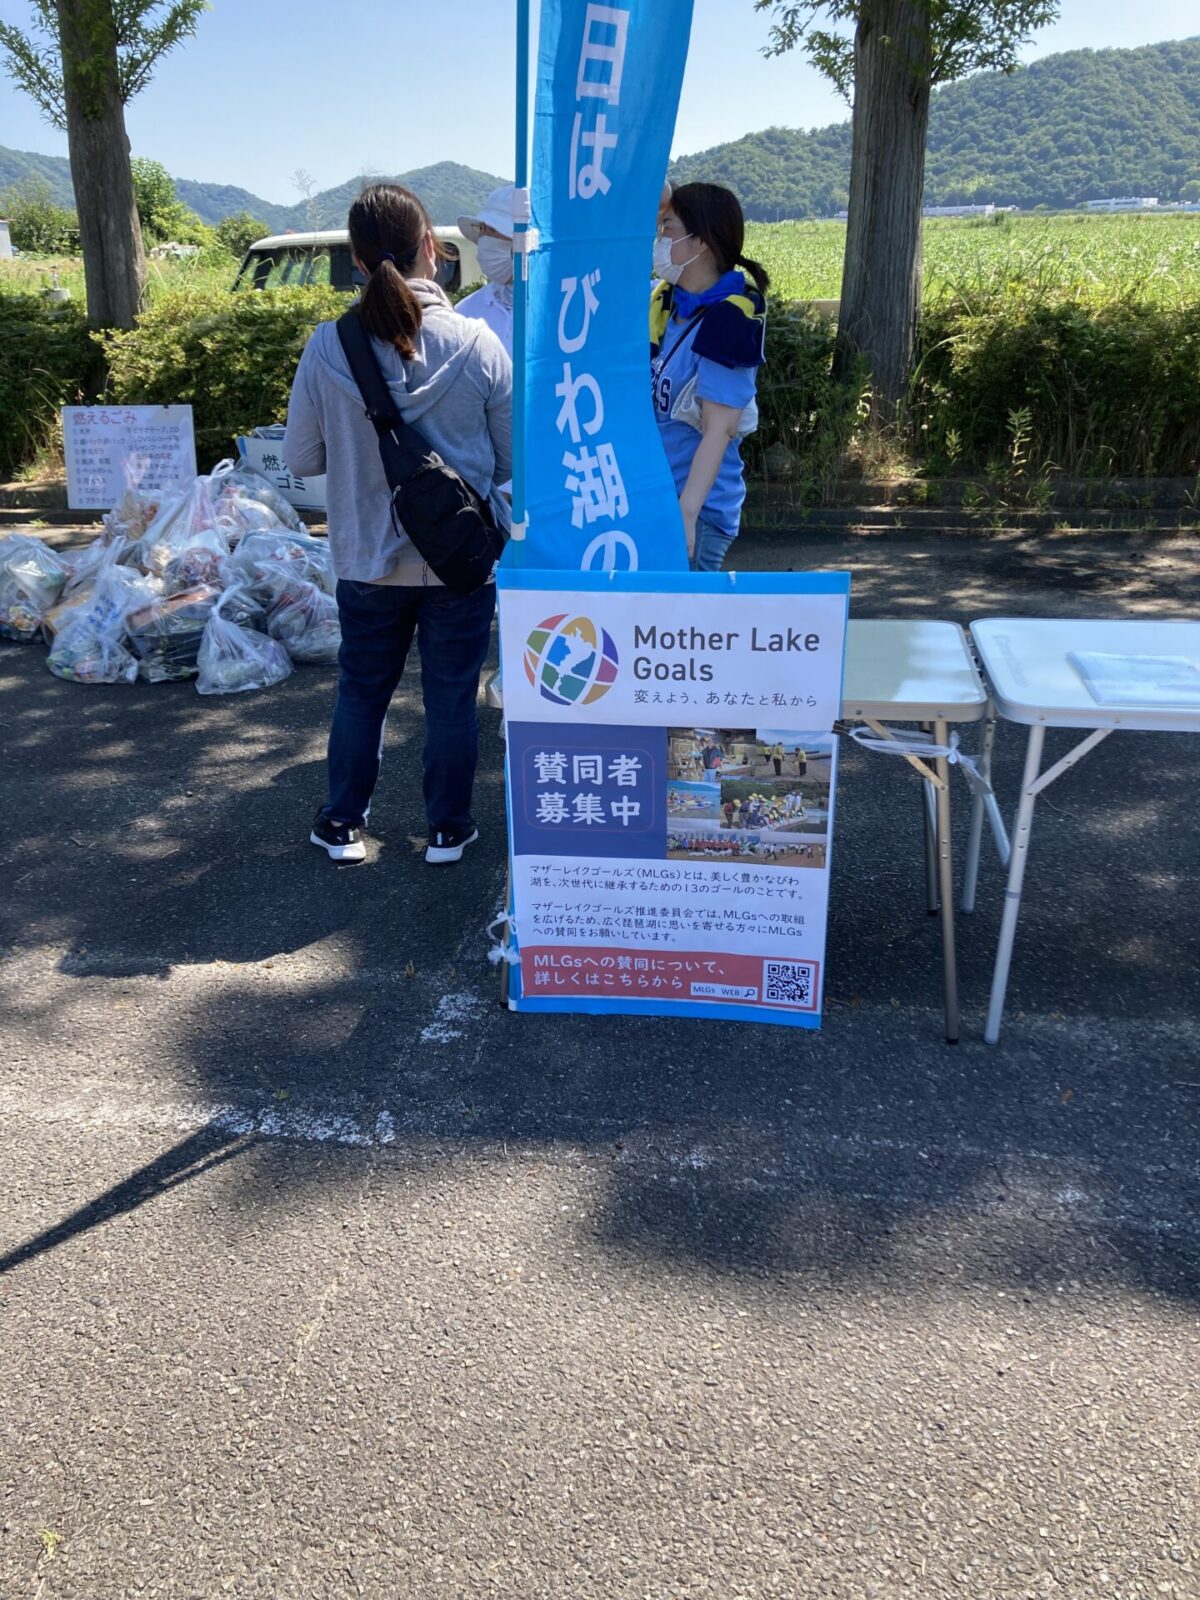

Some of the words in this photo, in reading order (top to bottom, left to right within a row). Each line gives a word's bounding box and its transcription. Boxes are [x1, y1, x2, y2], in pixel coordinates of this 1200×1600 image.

[568, 2, 631, 201] 日は
[73, 410, 137, 425] 燃えるごみ
[555, 267, 639, 572] びわ湖の
[262, 453, 289, 472] 燃
[276, 474, 306, 492] ゴミ
[634, 625, 740, 651] Mother
[751, 627, 820, 653] Lake
[633, 656, 714, 682] Goals
[633, 689, 818, 708] 変えよう、あなたと私から
[533, 751, 643, 788] 賛同者
[535, 792, 642, 828] 募集中
[533, 954, 726, 975] MLGsへの賛同について、
[533, 970, 684, 990] 詳しくはこちらから
[693, 985, 716, 994] MLGs
[721, 987, 740, 997] WEB
